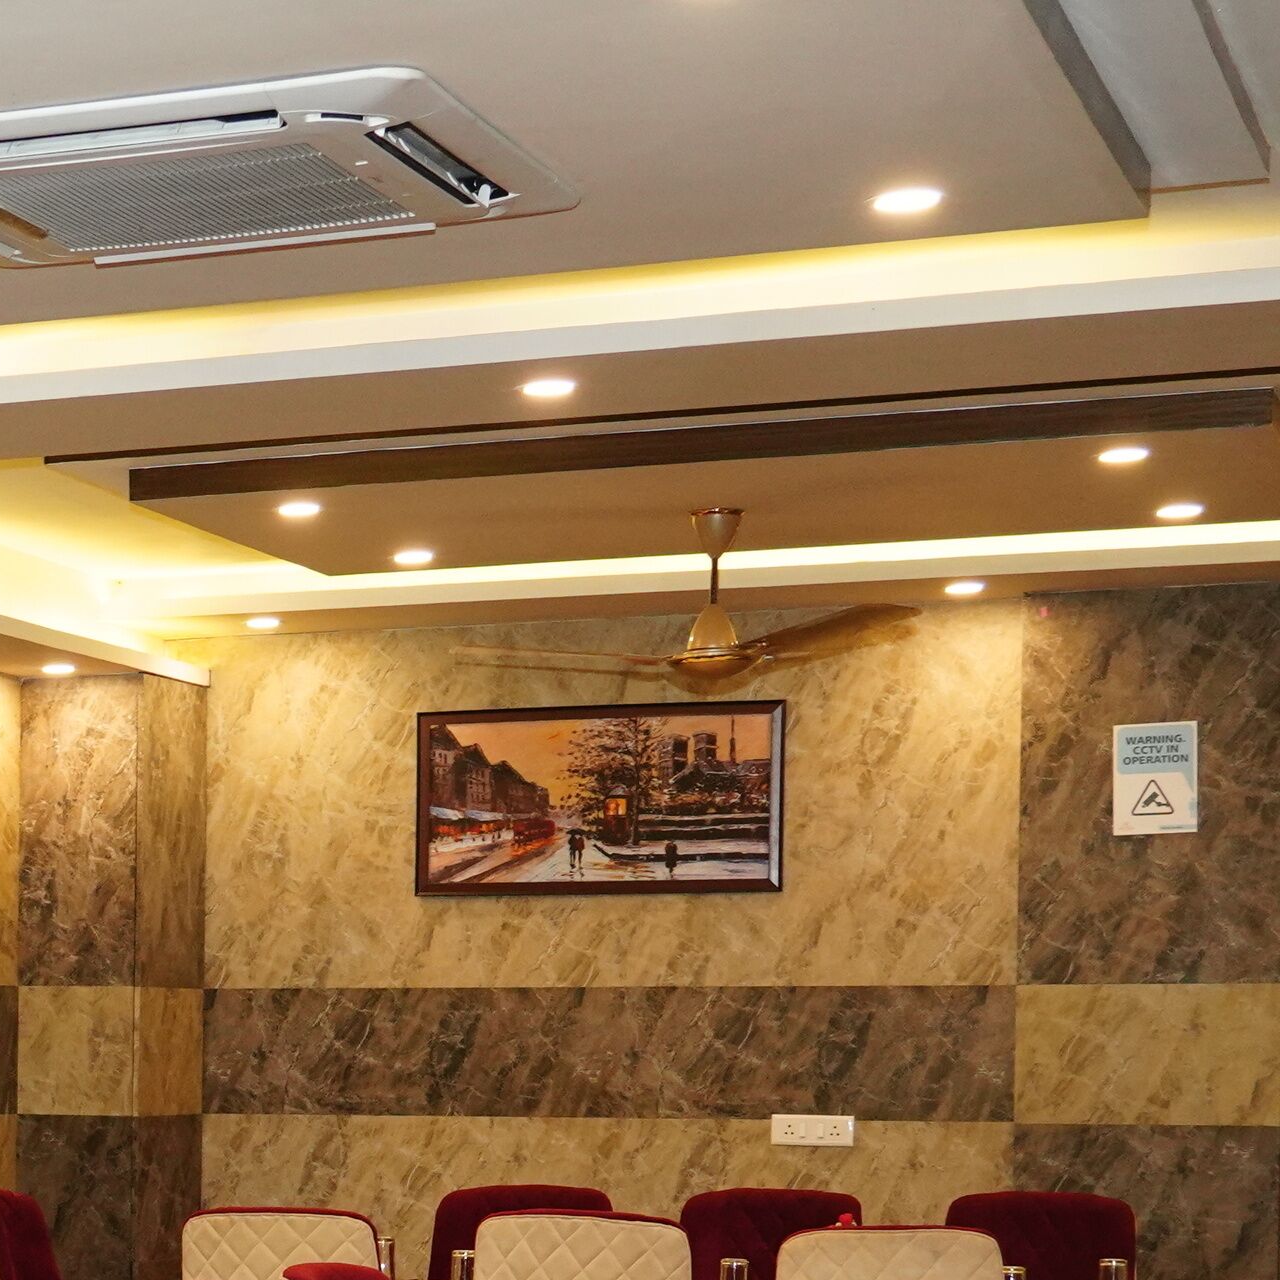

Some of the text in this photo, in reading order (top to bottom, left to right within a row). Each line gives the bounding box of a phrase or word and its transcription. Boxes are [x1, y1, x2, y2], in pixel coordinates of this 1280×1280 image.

[1133, 744, 1179, 755] CCTV IN
[1123, 754, 1189, 765] OPERATION
